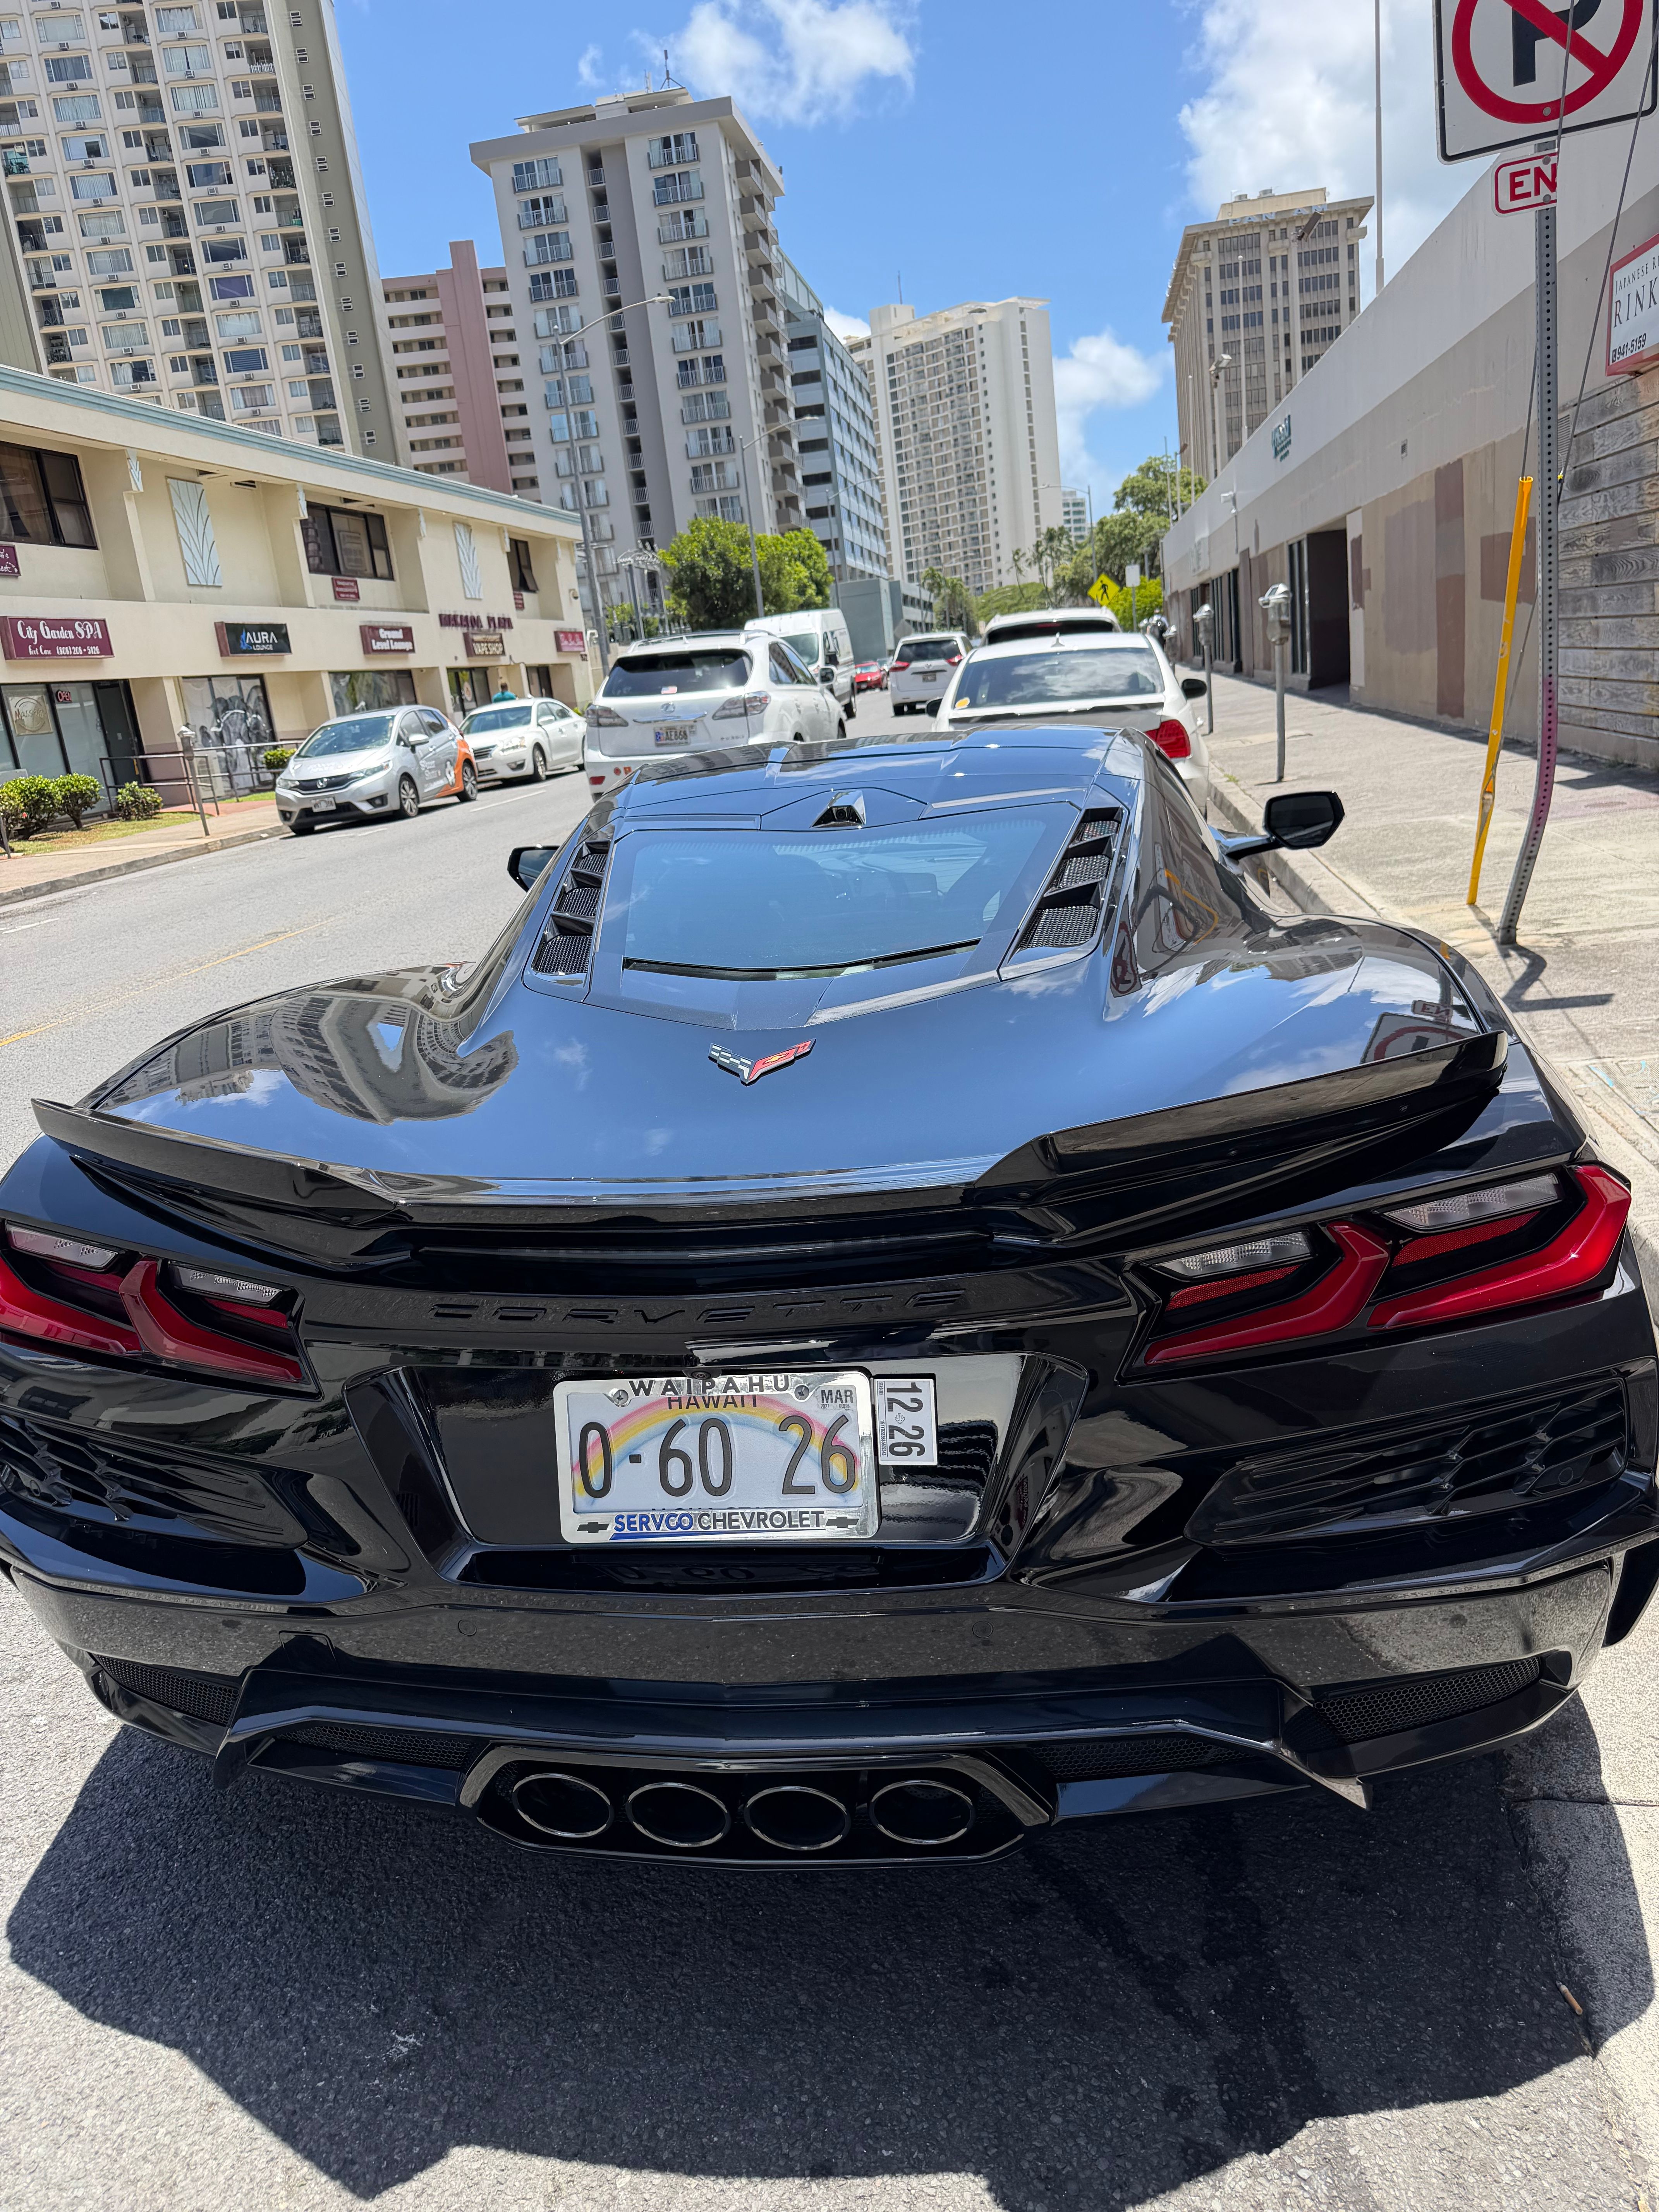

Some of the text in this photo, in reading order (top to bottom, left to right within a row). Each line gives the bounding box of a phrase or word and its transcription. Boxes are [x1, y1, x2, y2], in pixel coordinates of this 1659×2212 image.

[1616, 263, 1649, 296] JAPANESE
[1617, 333, 1646, 361] 941-5159
[17, 620, 102, 645] City Garden SPA
[246, 632, 278, 643] AURA
[56, 646, 72, 655] (808)
[372, 639, 412, 651] Level Lounge
[58, 690, 72, 702] OPEN
[428, 1288, 966, 1324] CORVETTE
[629, 1374, 789, 1396] WAIPAHU
[821, 1389, 854, 1403] MAR
[668, 1394, 757, 1410] HAWAII
[778, 1414, 855, 1494] 26
[614, 1510, 824, 1532] SERVCO CHEVROLET
